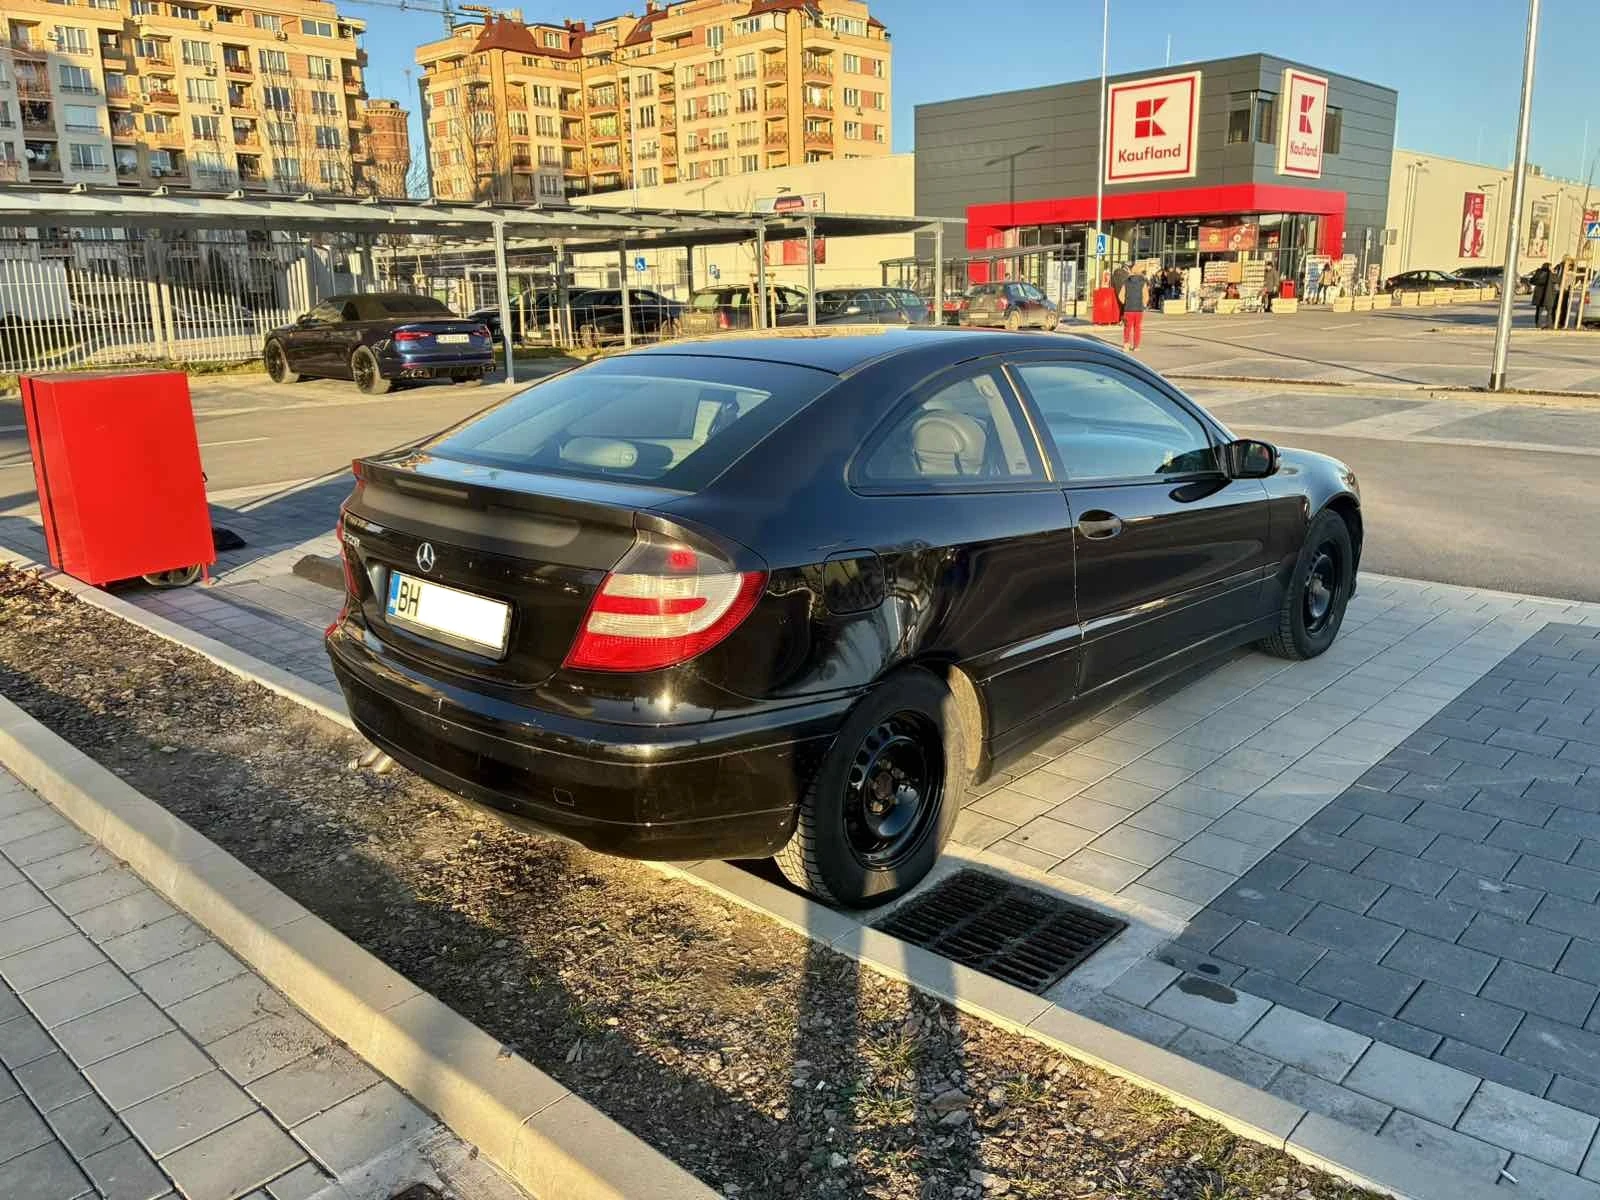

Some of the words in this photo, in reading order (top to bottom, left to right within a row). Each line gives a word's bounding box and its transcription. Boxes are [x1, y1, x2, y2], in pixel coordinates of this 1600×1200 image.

[1135, 96, 1168, 138] K
[1300, 94, 1315, 134] K
[1118, 143, 1181, 163] Kaufland
[1290, 141, 1318, 157] Kaufland
[398, 581, 421, 617] BH
